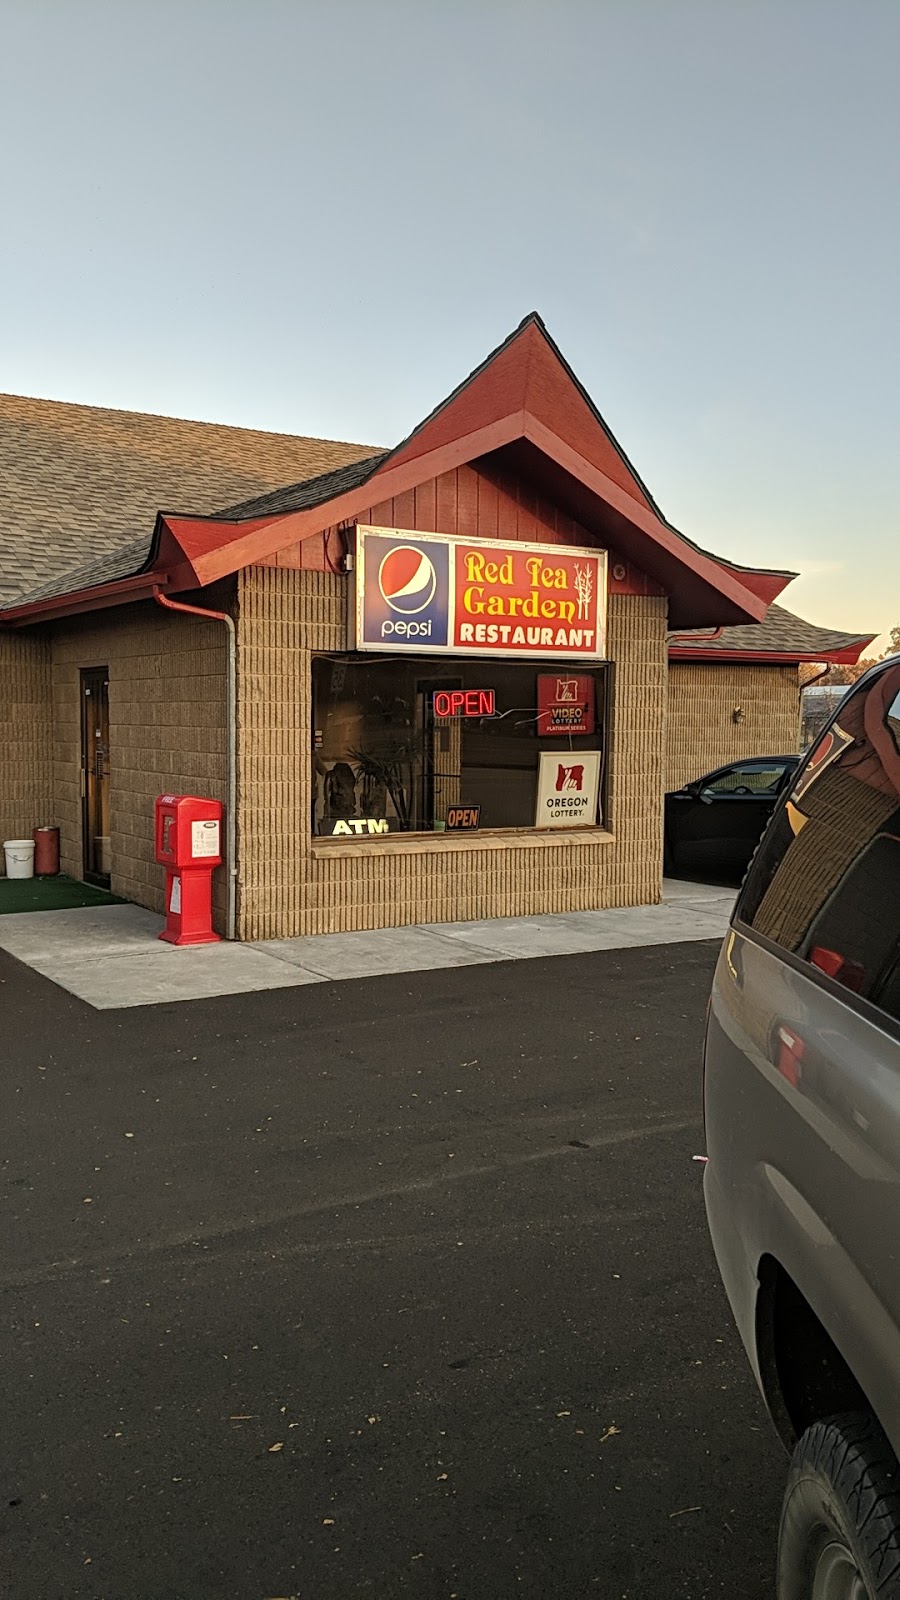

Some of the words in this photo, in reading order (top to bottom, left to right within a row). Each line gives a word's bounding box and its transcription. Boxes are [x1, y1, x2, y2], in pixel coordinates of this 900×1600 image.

[464, 551, 513, 585] Red
[526, 557, 568, 589] Tea
[464, 586, 576, 624] Garden
[382, 619, 432, 639] pepsi
[460, 622, 594, 648] RESTAURANT
[434, 690, 494, 717] OPEN
[551, 707, 583, 719] VIDEO
[546, 797, 588, 808] OREGON
[332, 818, 389, 836] ATM
[447, 809, 478, 828] OPEN
